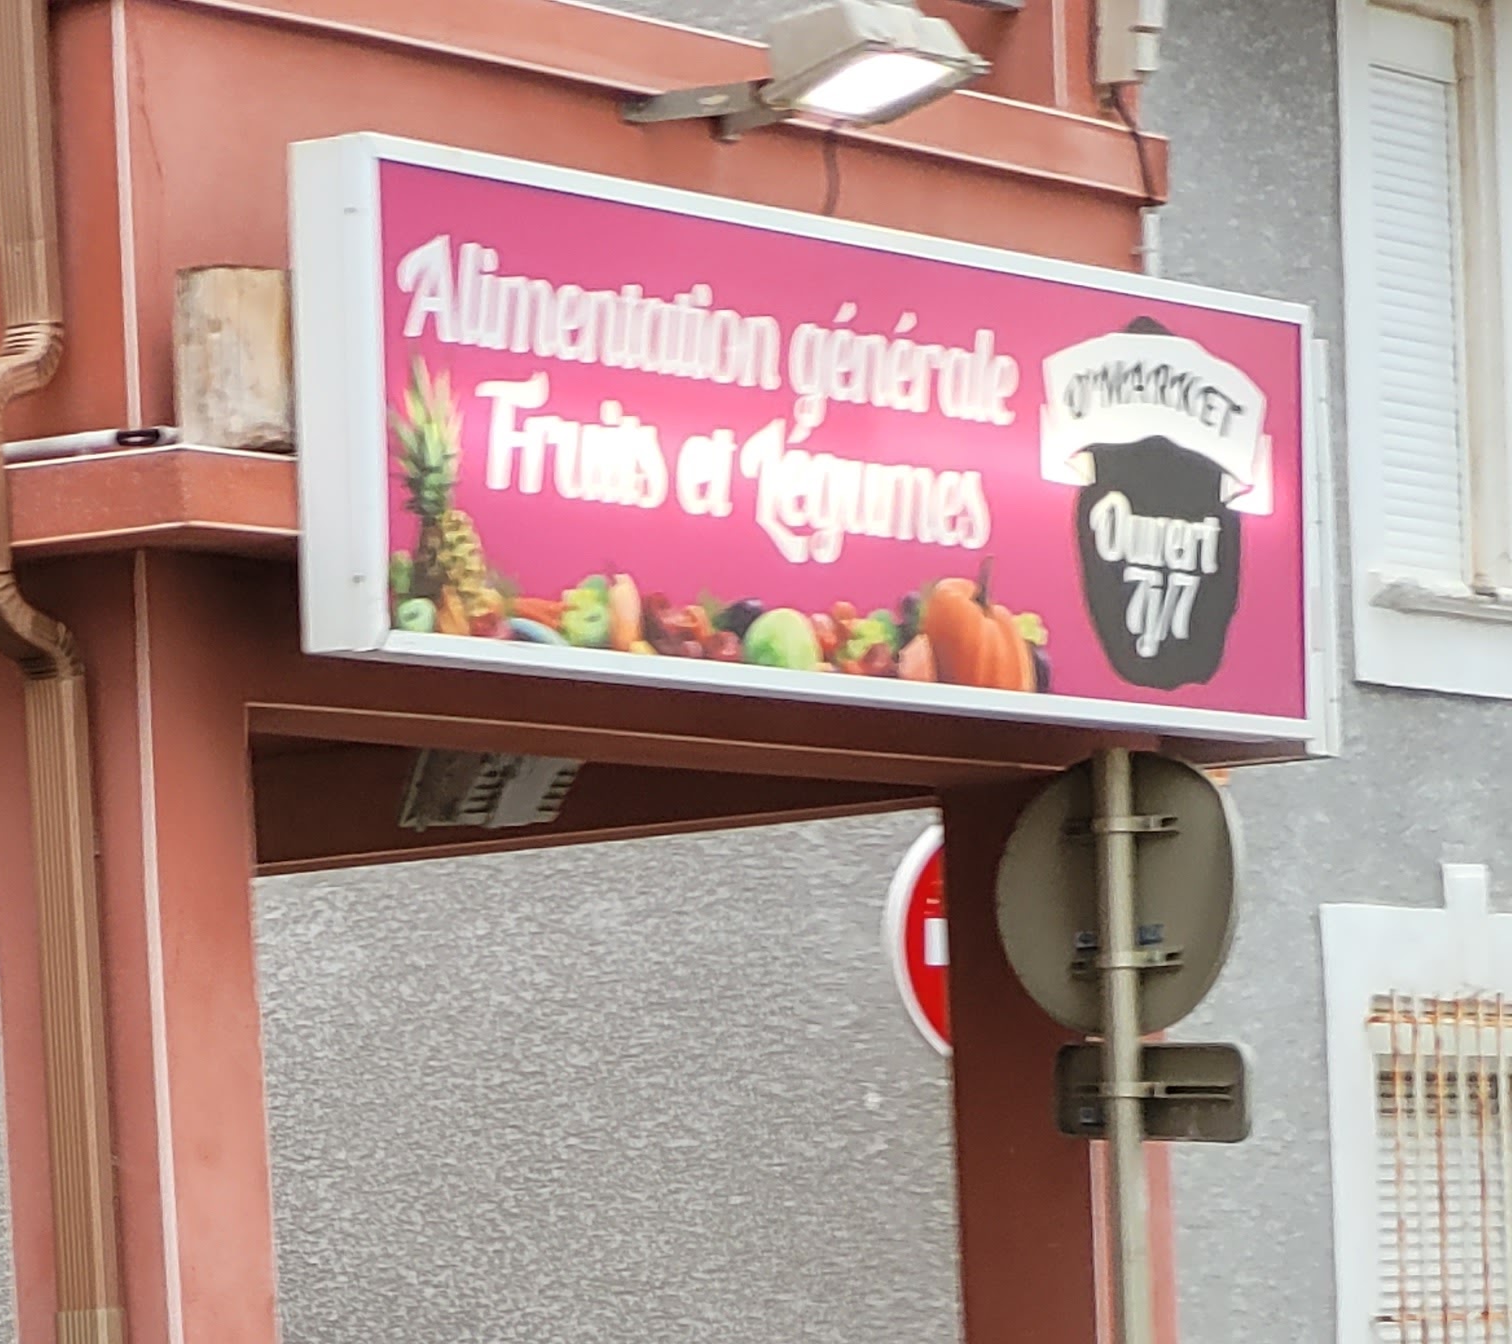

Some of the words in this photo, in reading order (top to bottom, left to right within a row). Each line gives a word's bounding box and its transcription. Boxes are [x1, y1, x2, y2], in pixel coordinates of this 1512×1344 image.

[396, 234, 782, 391] Alimentation
[790, 301, 1020, 427] générale
[1064, 361, 1243, 438] O'MARKET
[475, 371, 669, 509] Fruits
[676, 428, 738, 518] et
[740, 417, 991, 564] Légumes
[1090, 490, 1222, 574] Ouvert
[1123, 566, 1201, 658] 7j/7
